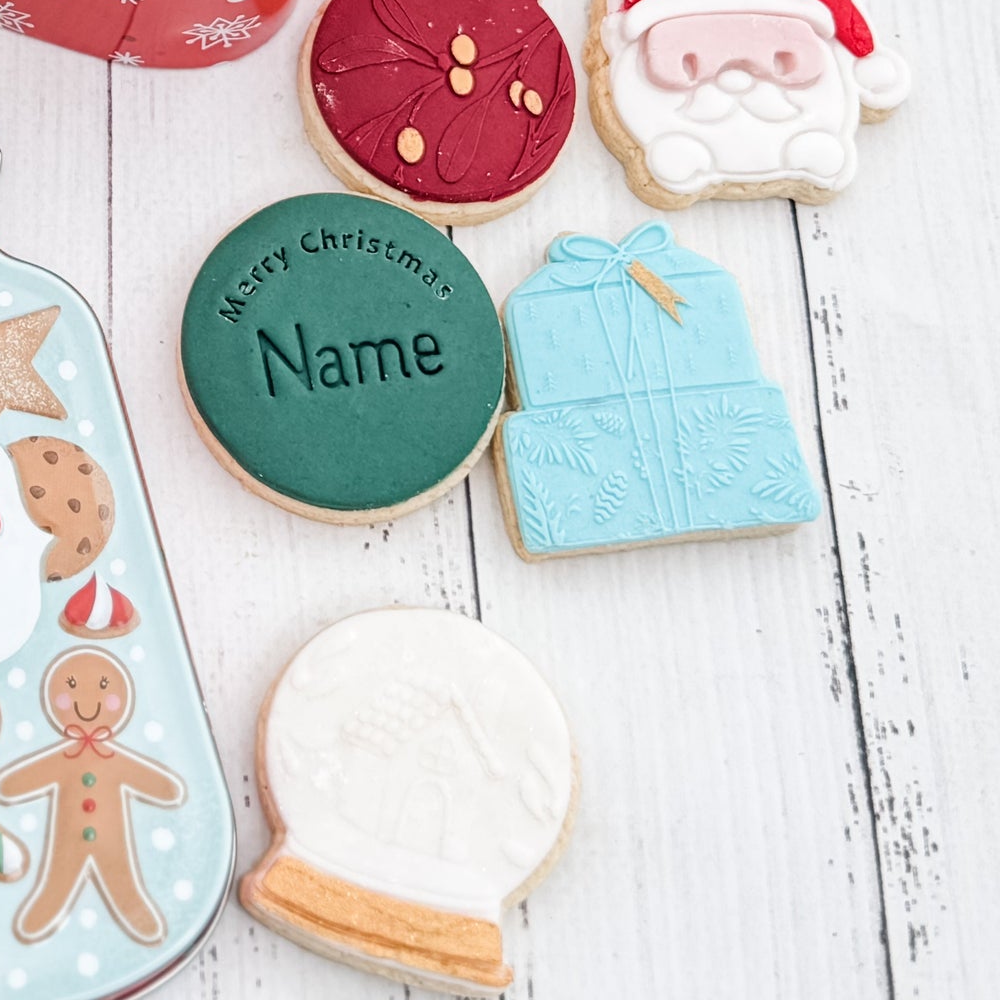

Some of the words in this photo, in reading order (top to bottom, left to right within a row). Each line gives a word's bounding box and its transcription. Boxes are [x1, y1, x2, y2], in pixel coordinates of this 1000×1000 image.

[218, 245, 289, 324] Merry
[299, 228, 454, 301] Christmas
[256, 322, 445, 399] Name
